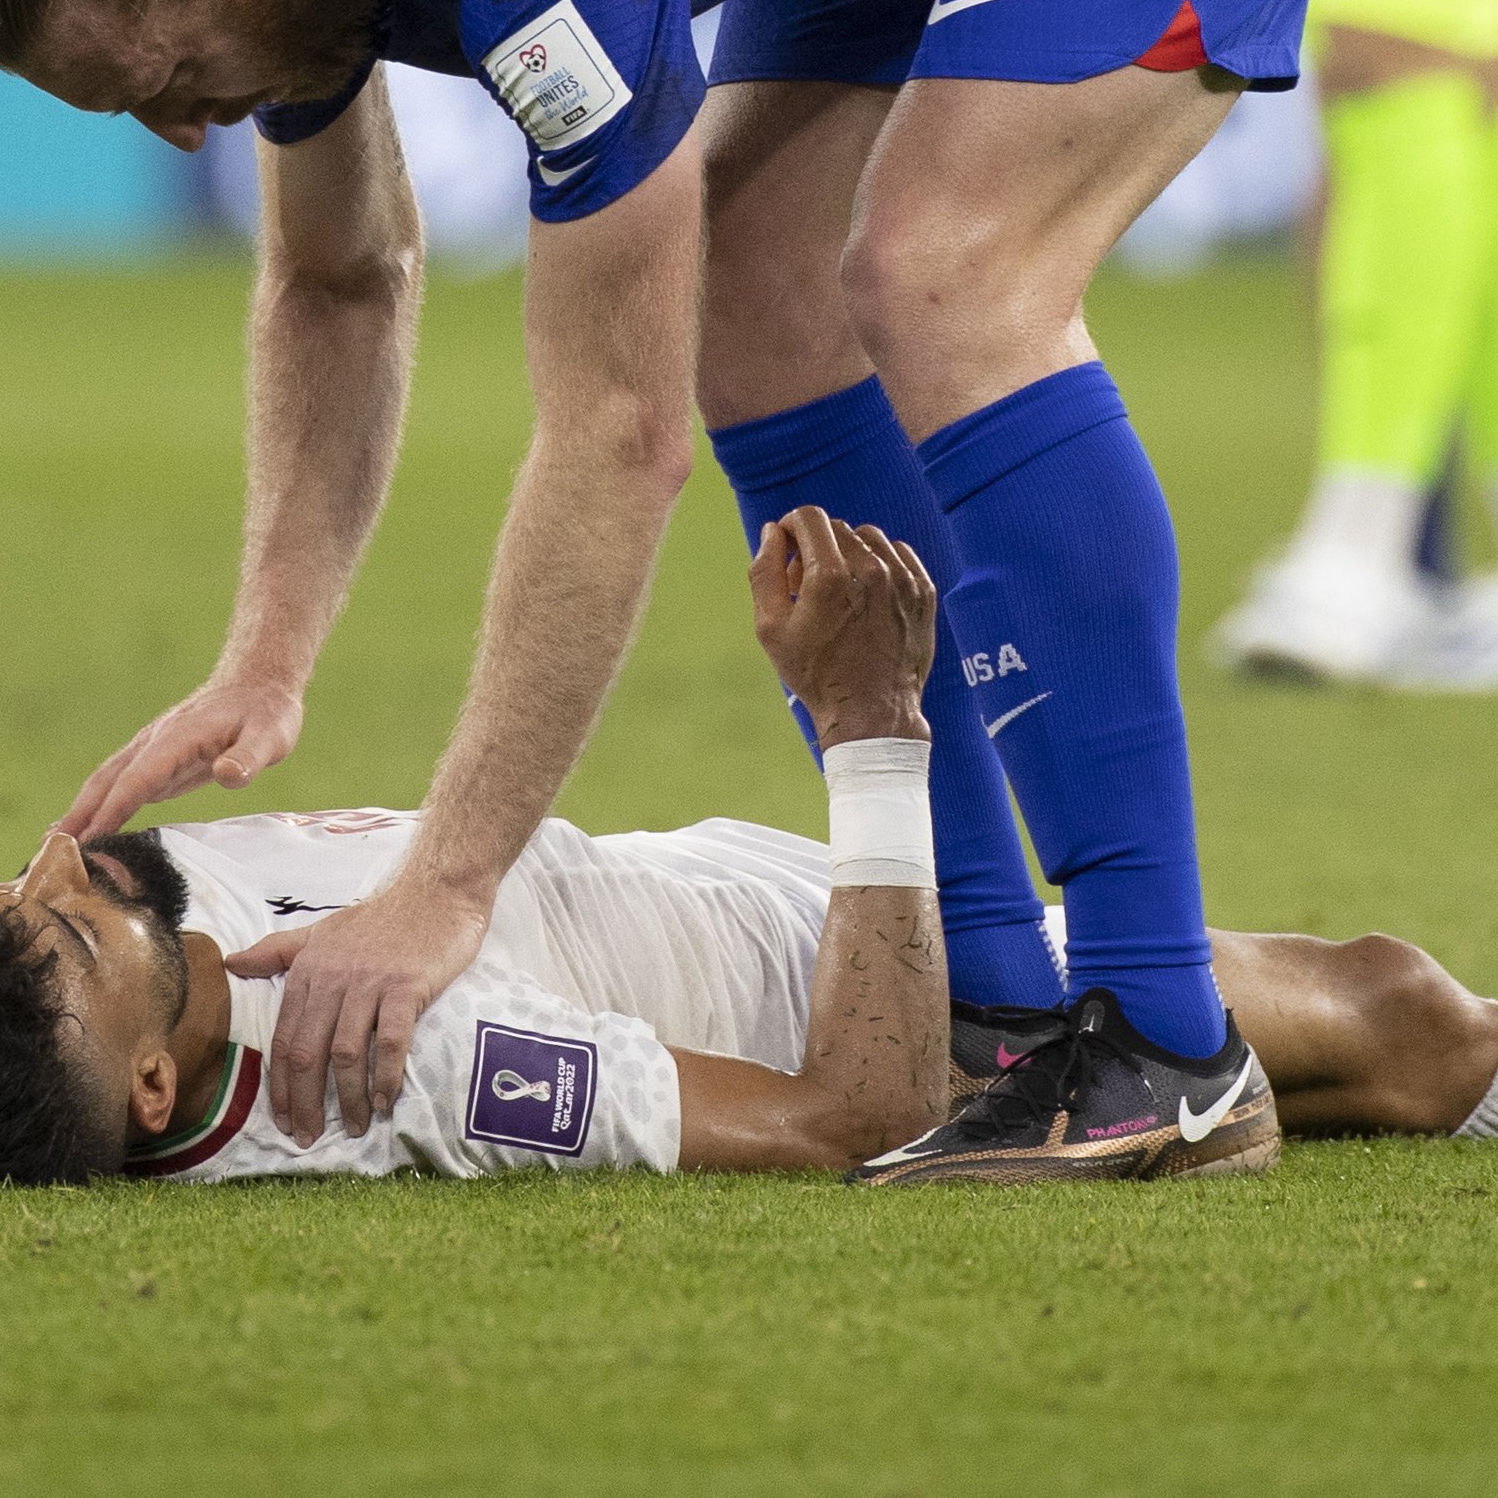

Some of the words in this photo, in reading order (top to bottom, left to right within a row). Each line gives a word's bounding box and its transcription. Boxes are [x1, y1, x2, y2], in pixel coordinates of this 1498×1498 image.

[536, 75, 579, 107] UNITES
[962, 643, 1028, 687] USA
[557, 1057, 566, 1076] CUP
[555, 1076, 565, 1111] WORLD
[551, 1111, 562, 1133] FIFA
